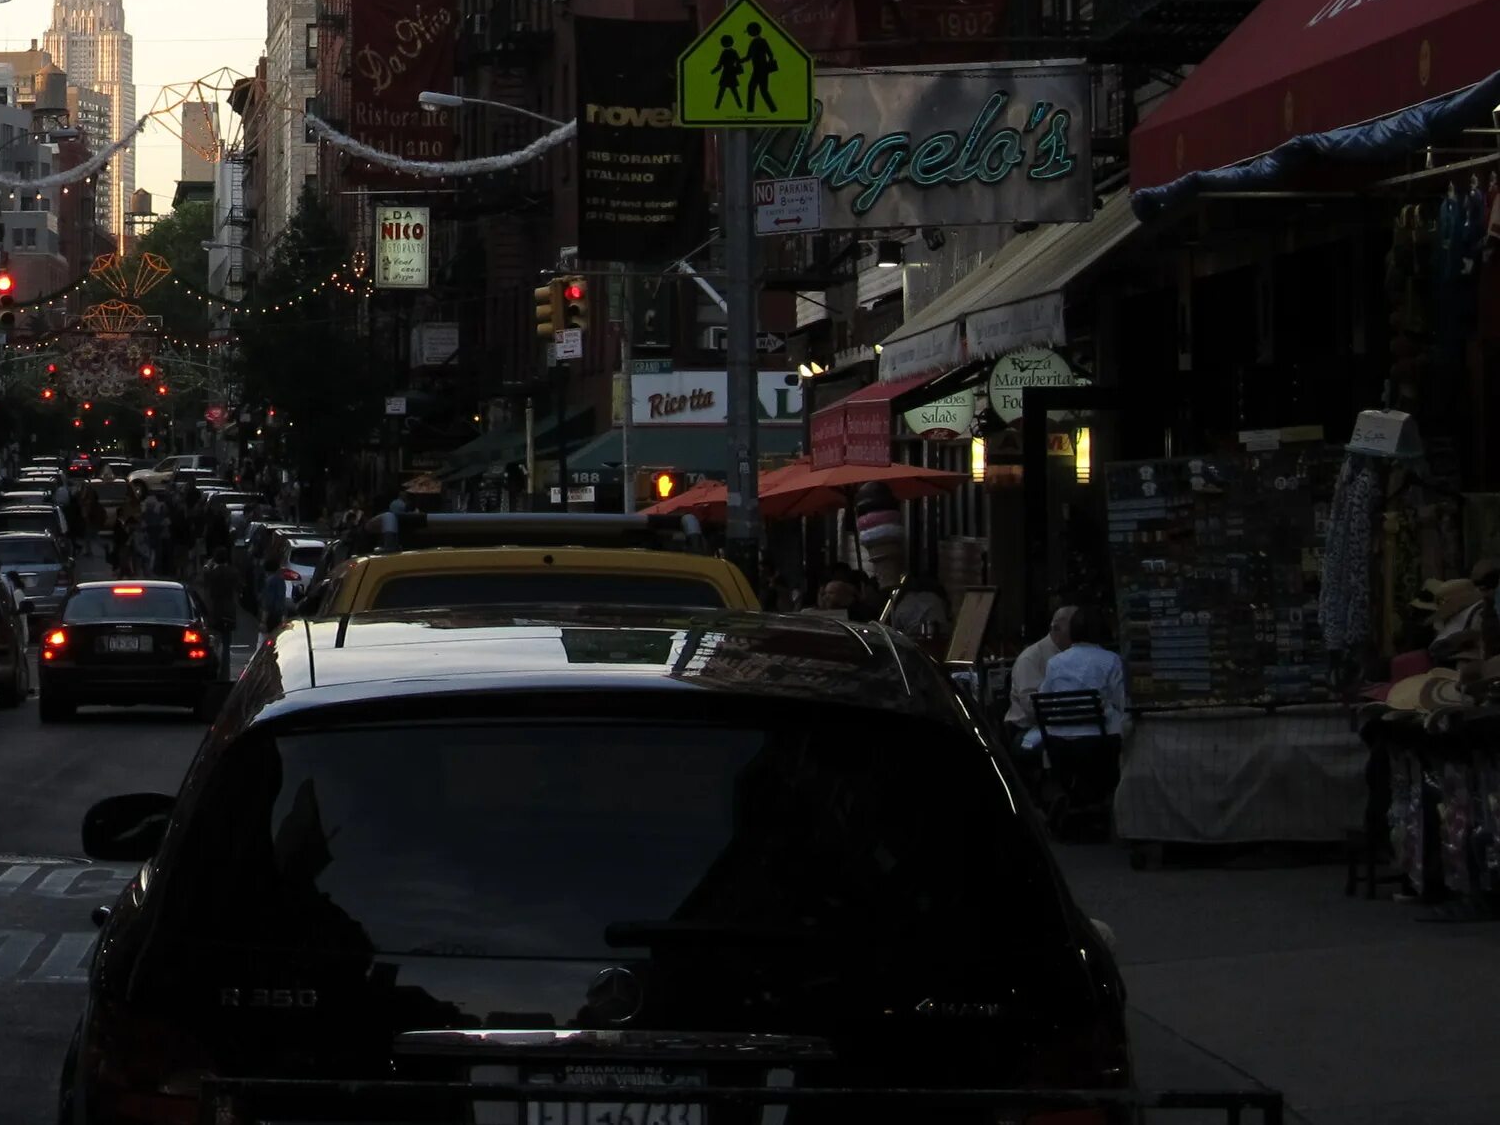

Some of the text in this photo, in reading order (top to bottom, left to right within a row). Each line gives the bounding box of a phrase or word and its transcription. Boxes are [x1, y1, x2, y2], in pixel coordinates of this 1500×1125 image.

[937, 10, 995, 37] 1902
[356, 6, 451, 96] Da Nico
[356, 101, 449, 126] Ristorante
[359, 131, 444, 157] Italiano
[752, 88, 1077, 215] Angelo's
[586, 150, 683, 164] RISTORANTE
[586, 168, 656, 183] ITALIANO
[756, 182, 814, 203] NO PARKING
[393, 210, 413, 220] DA
[381, 222, 424, 241] NICO
[759, 338, 778, 348] WAY
[634, 361, 660, 373] GRAND
[1012, 358, 1051, 372] Pizza
[994, 371, 1072, 388] Margherita
[648, 388, 715, 419] Ricotta
[921, 407, 958, 424] Salads
[572, 472, 600, 484] 188
[219, 987, 318, 1008] R 350
